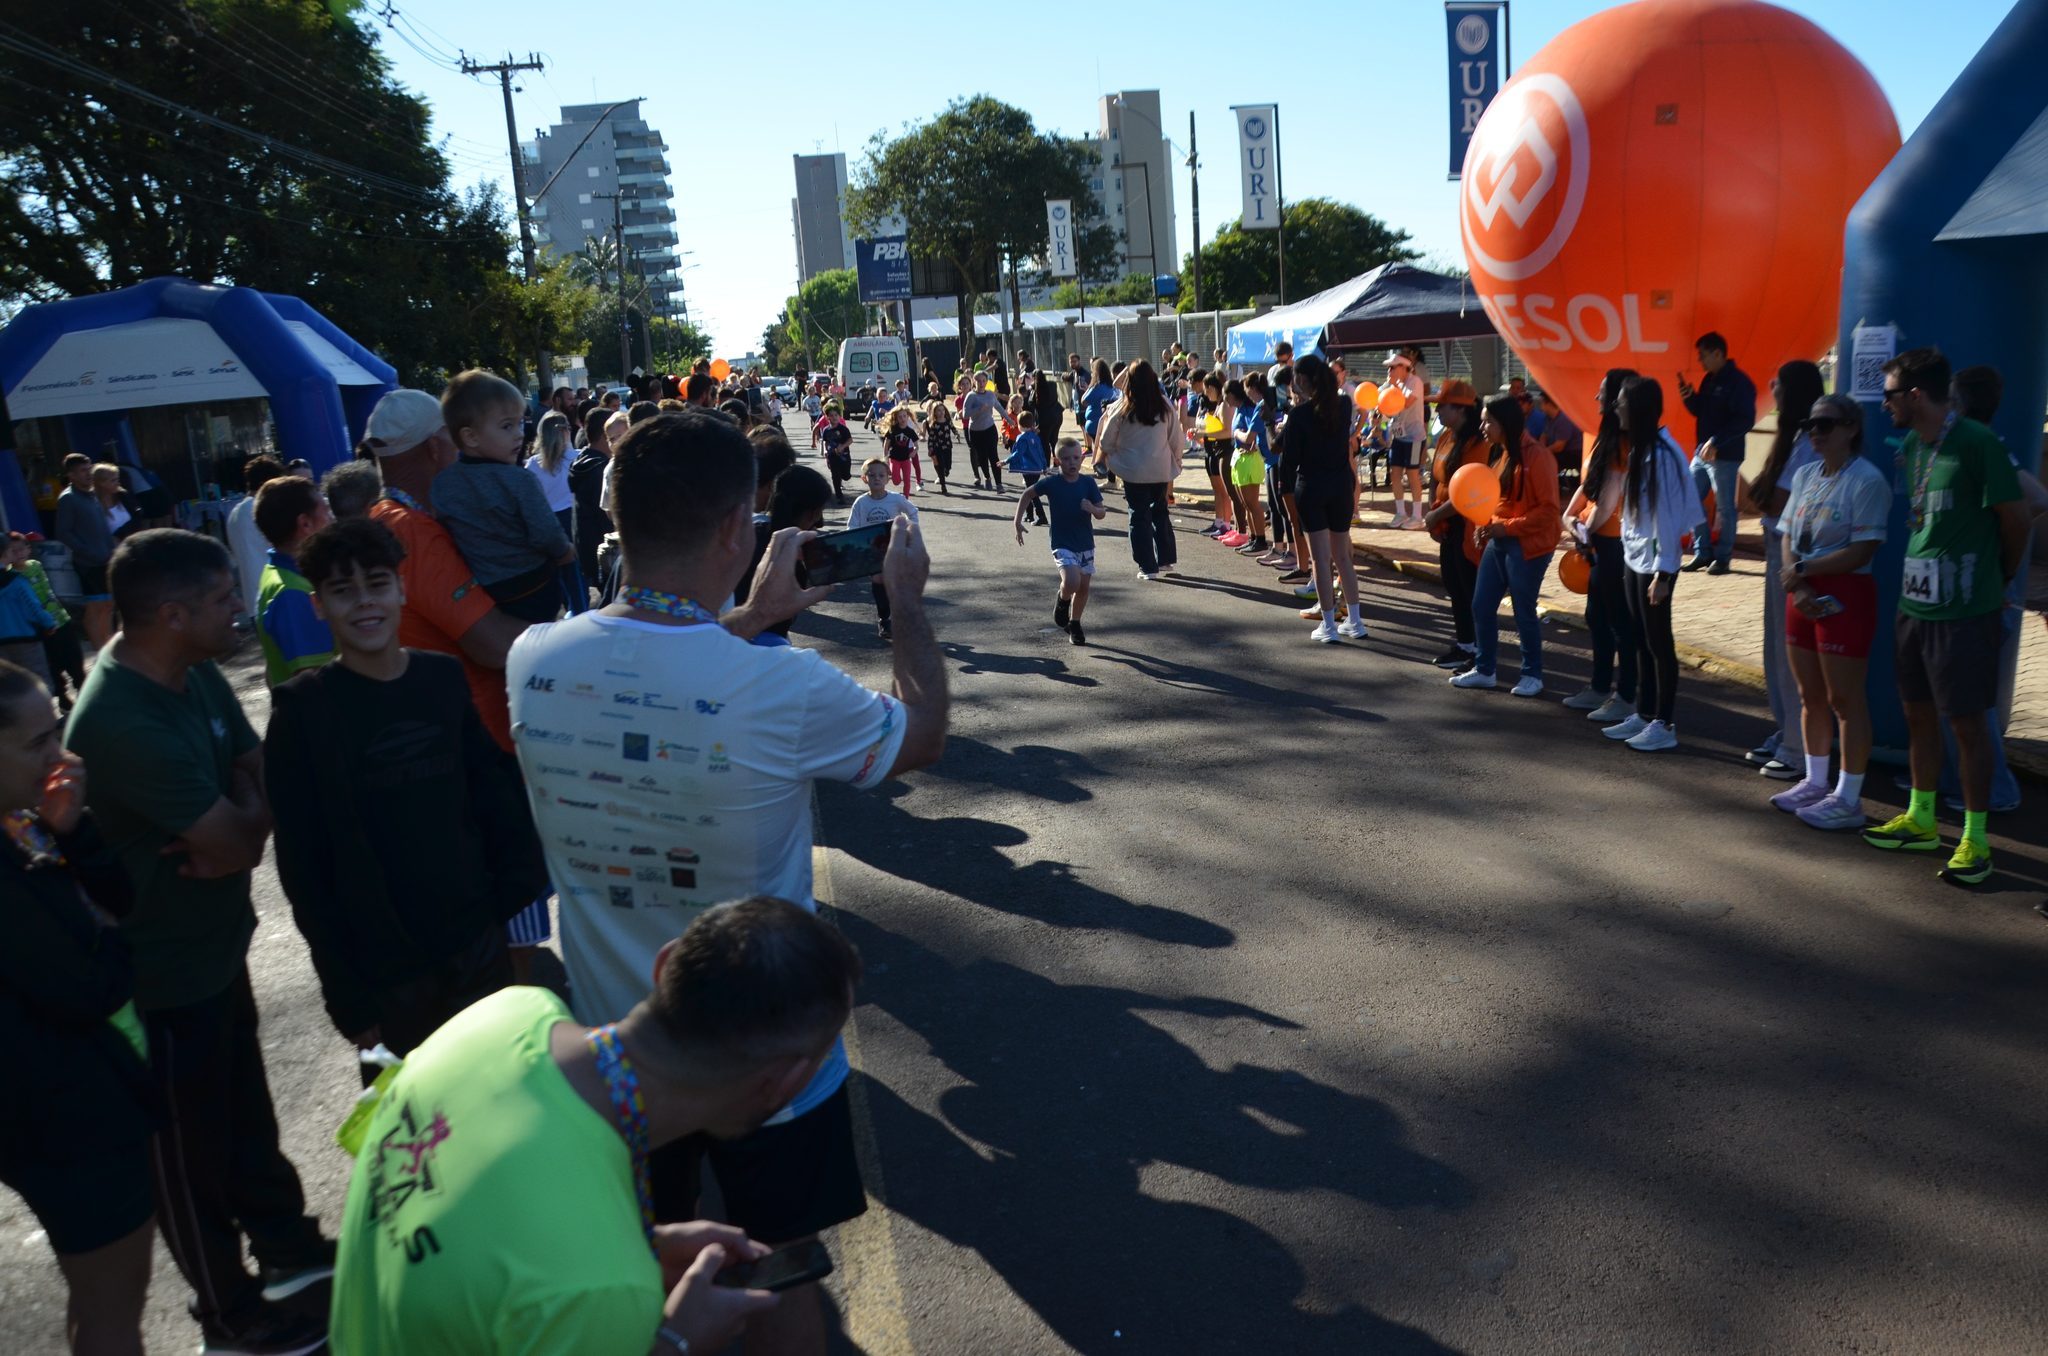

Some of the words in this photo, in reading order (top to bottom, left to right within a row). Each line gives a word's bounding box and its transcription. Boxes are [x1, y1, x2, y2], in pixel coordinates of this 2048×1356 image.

[1459, 60, 1489, 141] UR
[1247, 146, 1268, 221] URI
[1055, 224, 1068, 270] URI
[108, 373, 157, 384] Sindicatos
[171, 369, 196, 378] Sesc
[208, 365, 239, 375] Senac
